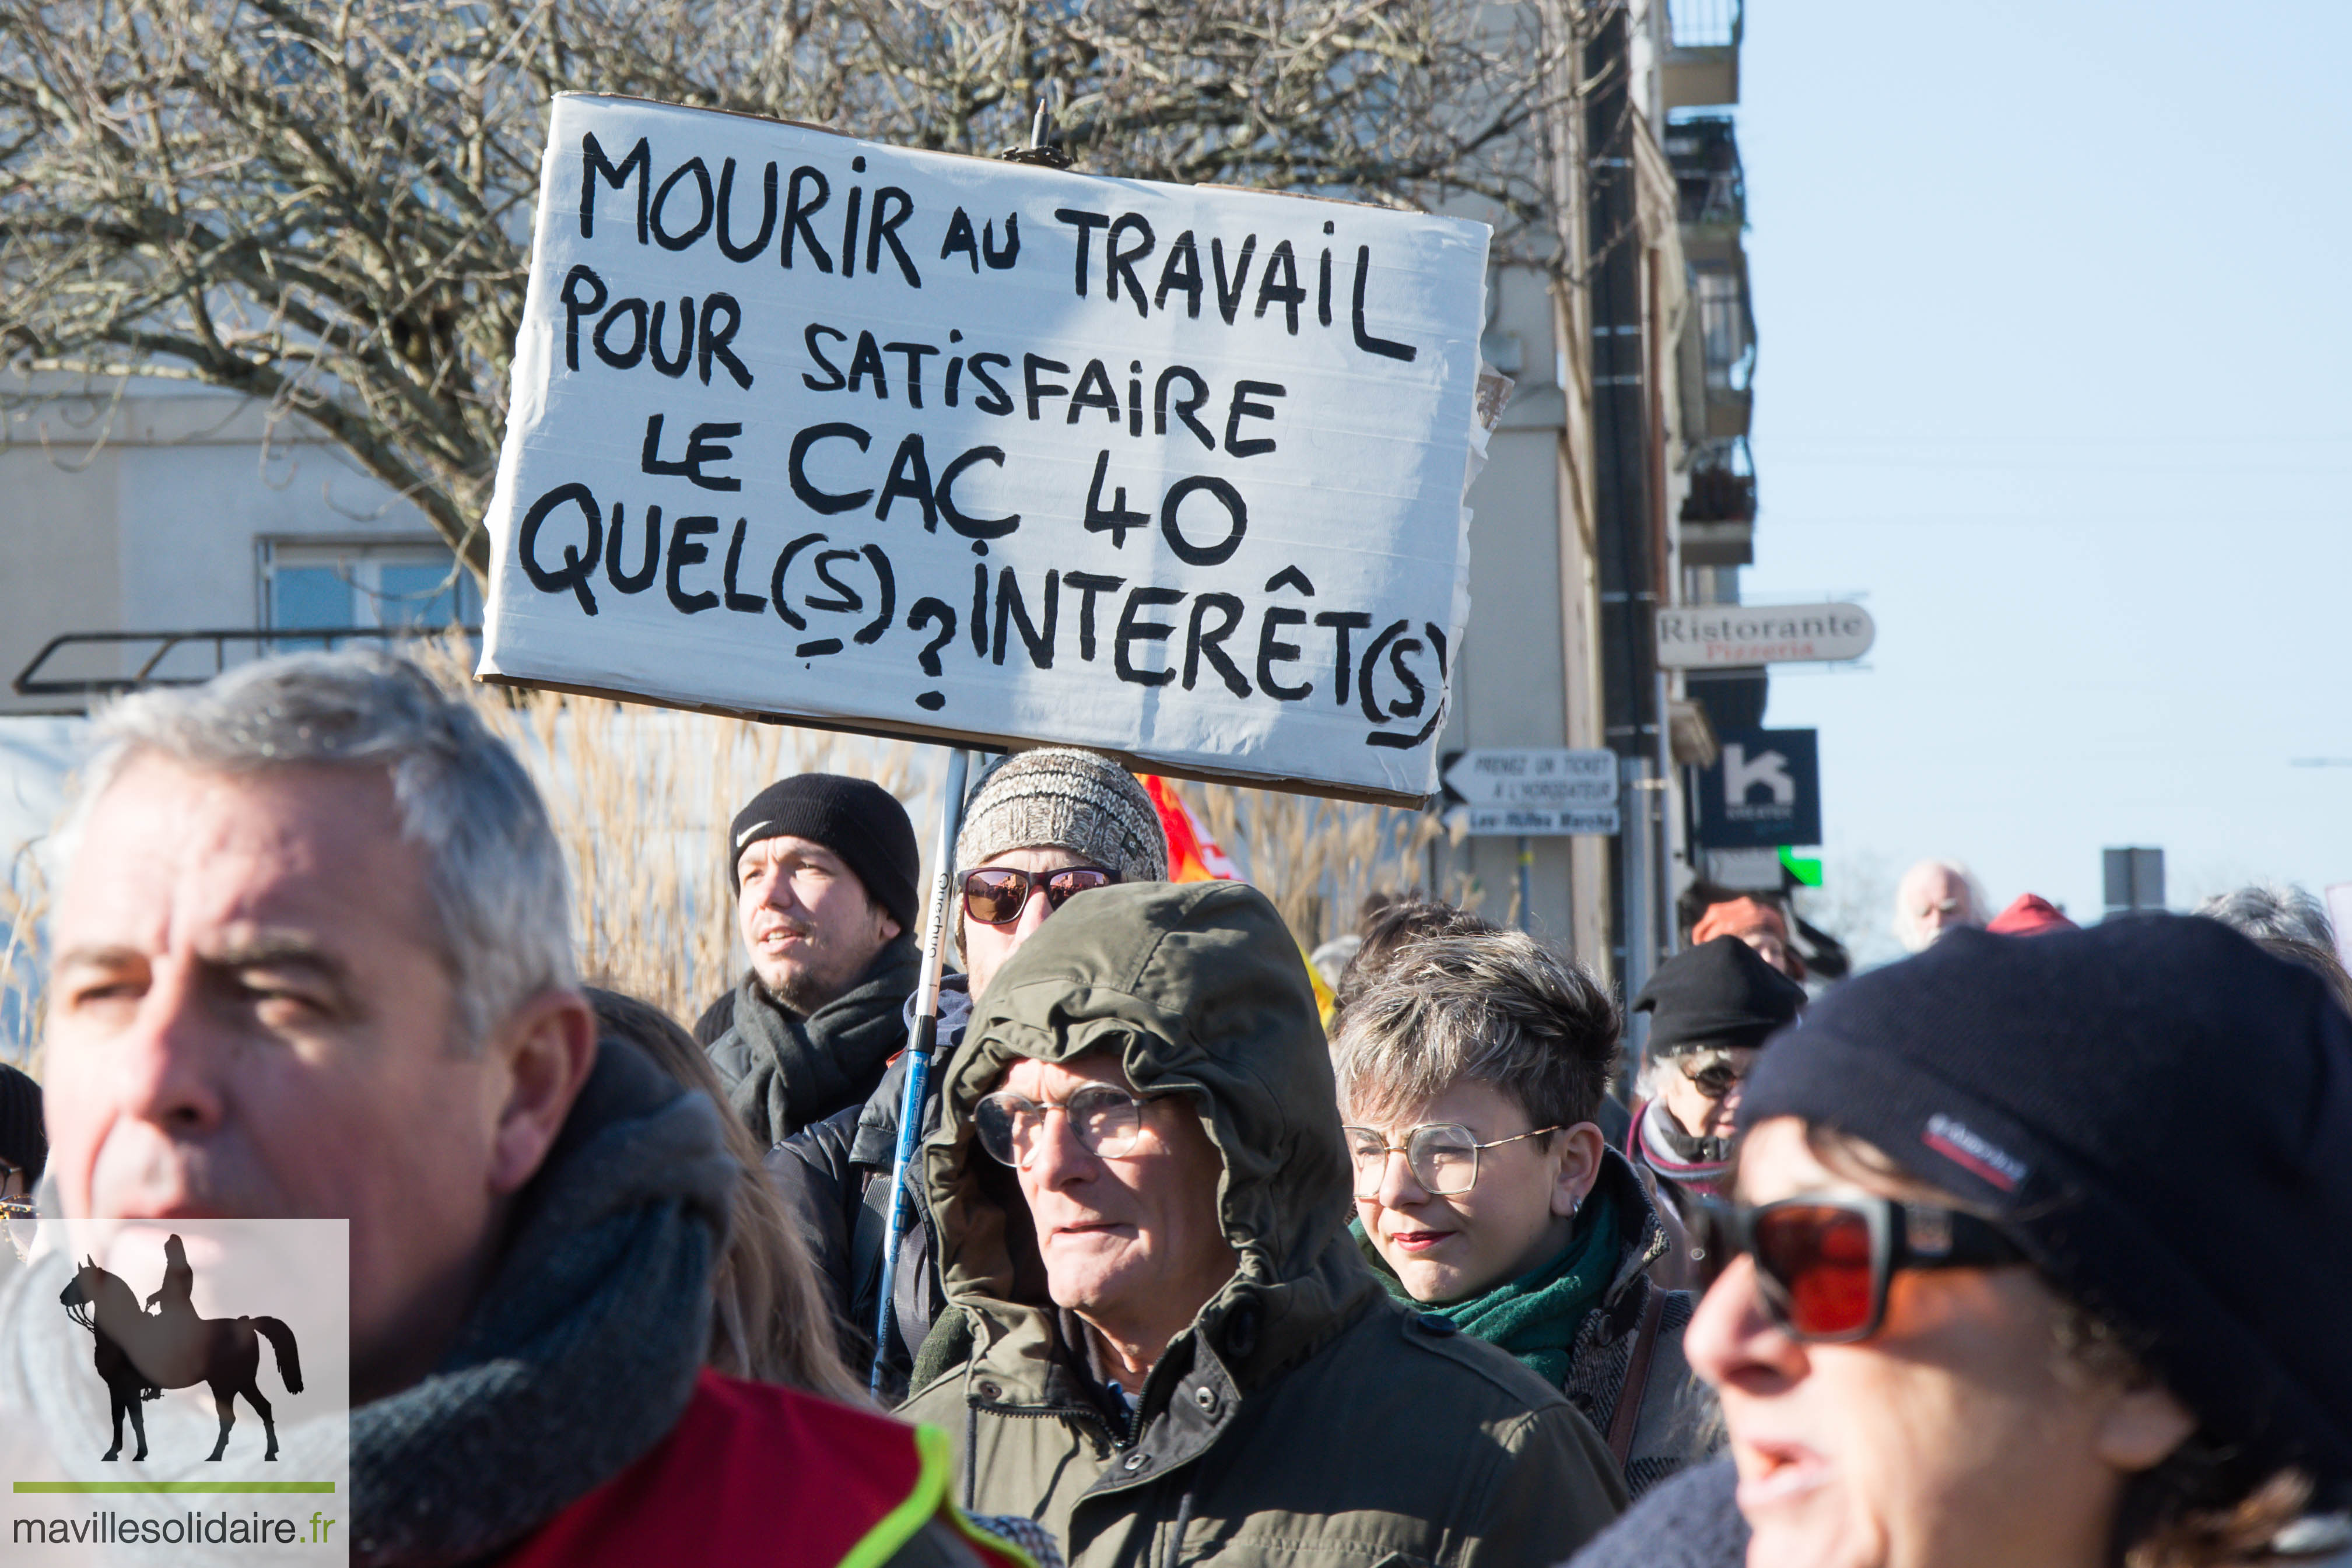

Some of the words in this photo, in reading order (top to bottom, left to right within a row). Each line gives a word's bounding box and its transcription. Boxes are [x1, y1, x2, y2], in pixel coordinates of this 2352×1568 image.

[941, 206, 1020, 273] AU
[561, 265, 753, 391] POUR
[642, 413, 742, 492] LE
[788, 423, 1021, 539] CAC
[1084, 450, 1247, 566] 40
[1660, 612, 1863, 643] Ristorante
[1474, 755, 1527, 776] PRENEZ
[1535, 756, 1554, 775] UN
[1564, 755, 1610, 775] TICKET
[928, 872, 949, 959] Quechua
